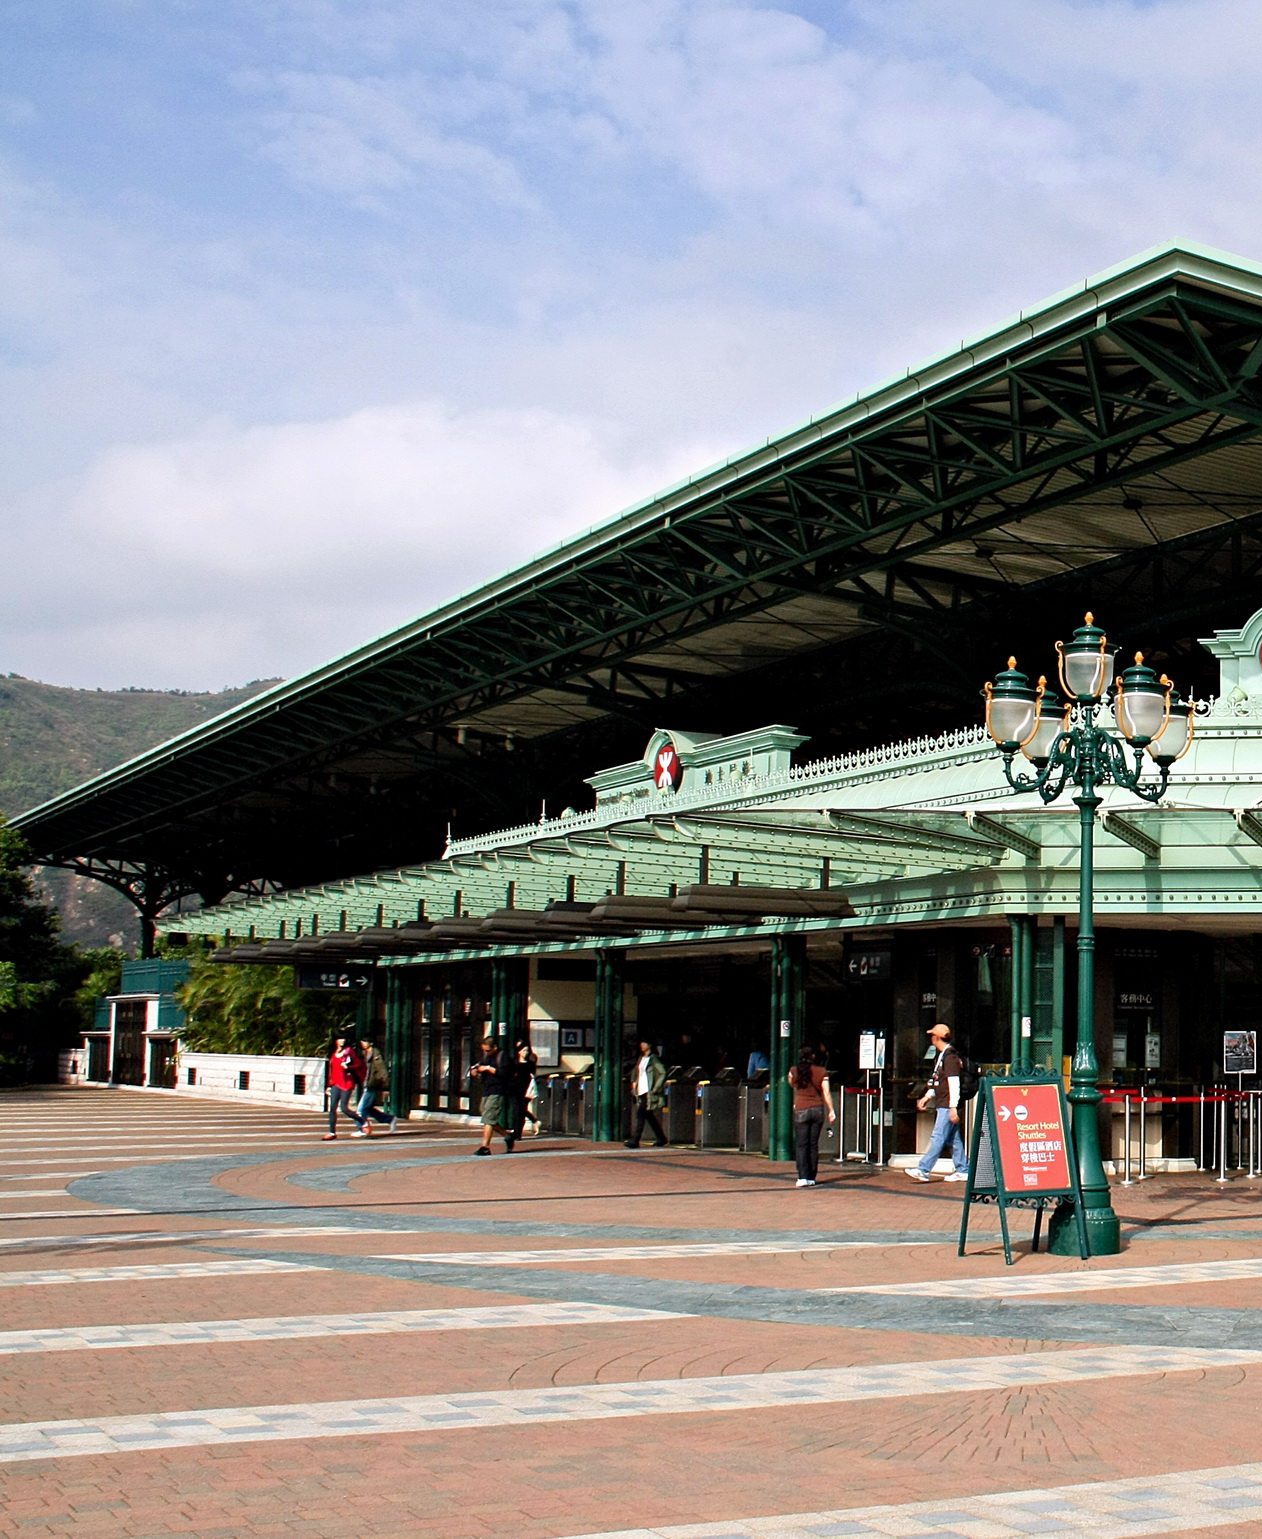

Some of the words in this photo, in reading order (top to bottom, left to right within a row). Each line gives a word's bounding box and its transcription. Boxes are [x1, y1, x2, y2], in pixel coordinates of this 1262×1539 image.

[1016, 1122, 1039, 1131] Resort
[1040, 1121, 1059, 1130] Hotel
[1018, 1131, 1047, 1140] Shuttles
